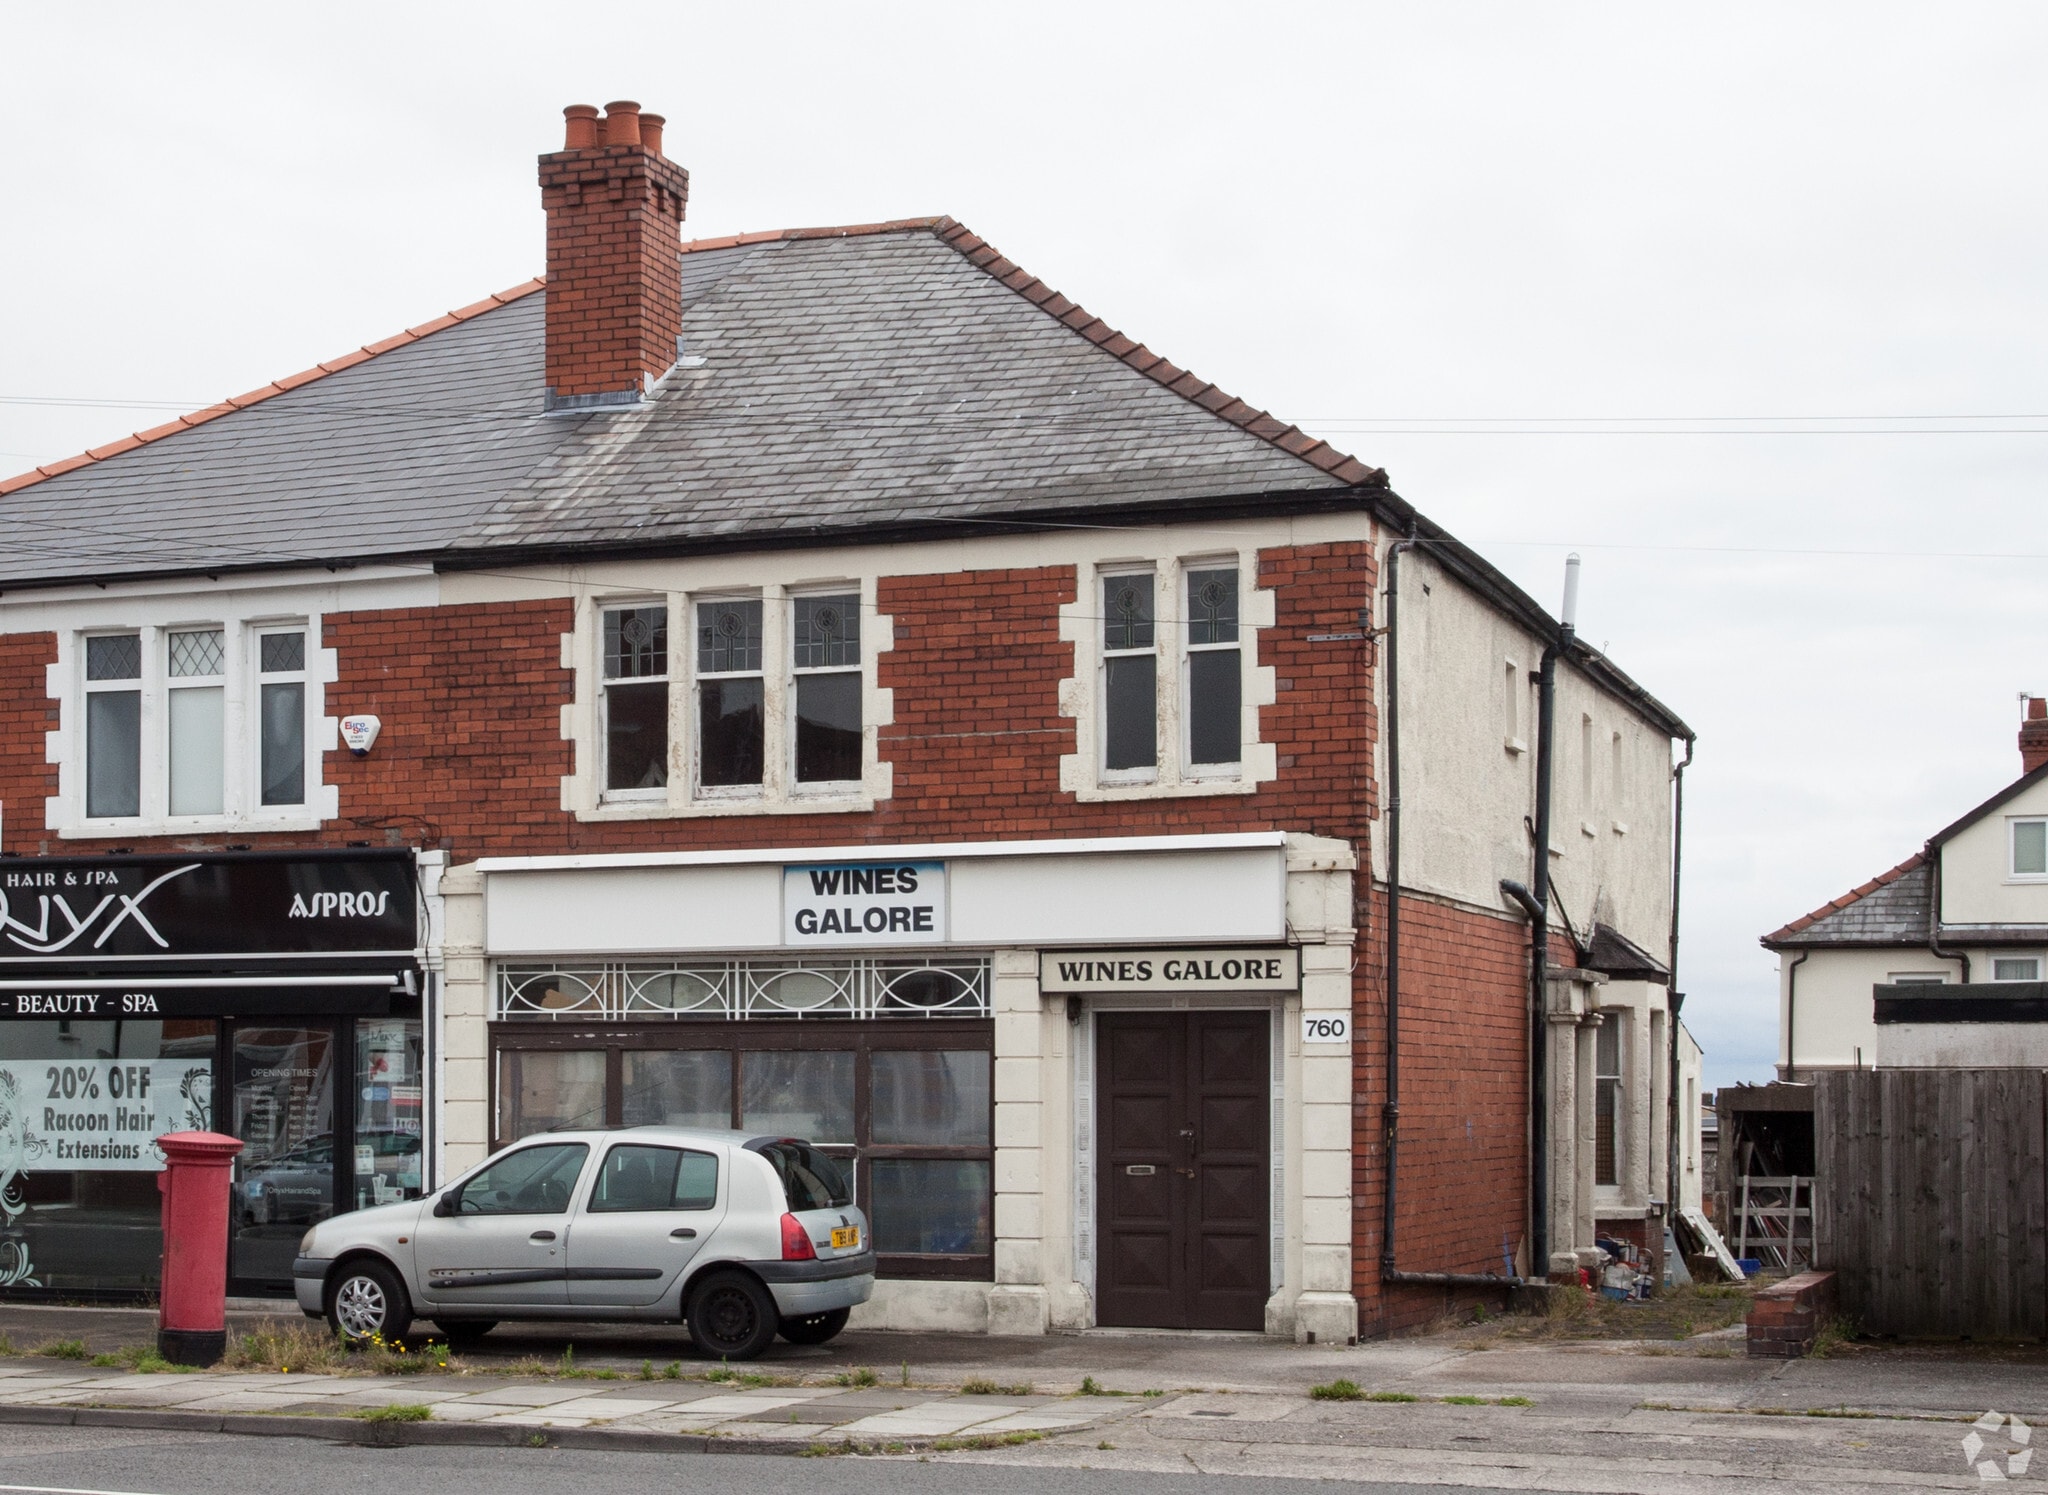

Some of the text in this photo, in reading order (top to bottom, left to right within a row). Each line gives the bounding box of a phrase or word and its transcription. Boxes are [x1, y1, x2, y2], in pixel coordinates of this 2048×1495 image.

[7, 871, 119, 887] HAIR & SPA
[809, 867, 918, 895] WINES
[288, 891, 390, 918] ASPROS
[795, 906, 934, 934] GALORE
[1058, 959, 1282, 982] WINES GALORE
[17, 995, 100, 1013] BEAUTY
[122, 994, 159, 1012] SPA
[1305, 1020, 1345, 1037] 760
[46, 1066, 151, 1099] 20% OFF
[251, 1068, 318, 1077] OPENING TIMES
[44, 1105, 155, 1131] Racoon Hair
[57, 1138, 140, 1159] Extensions
